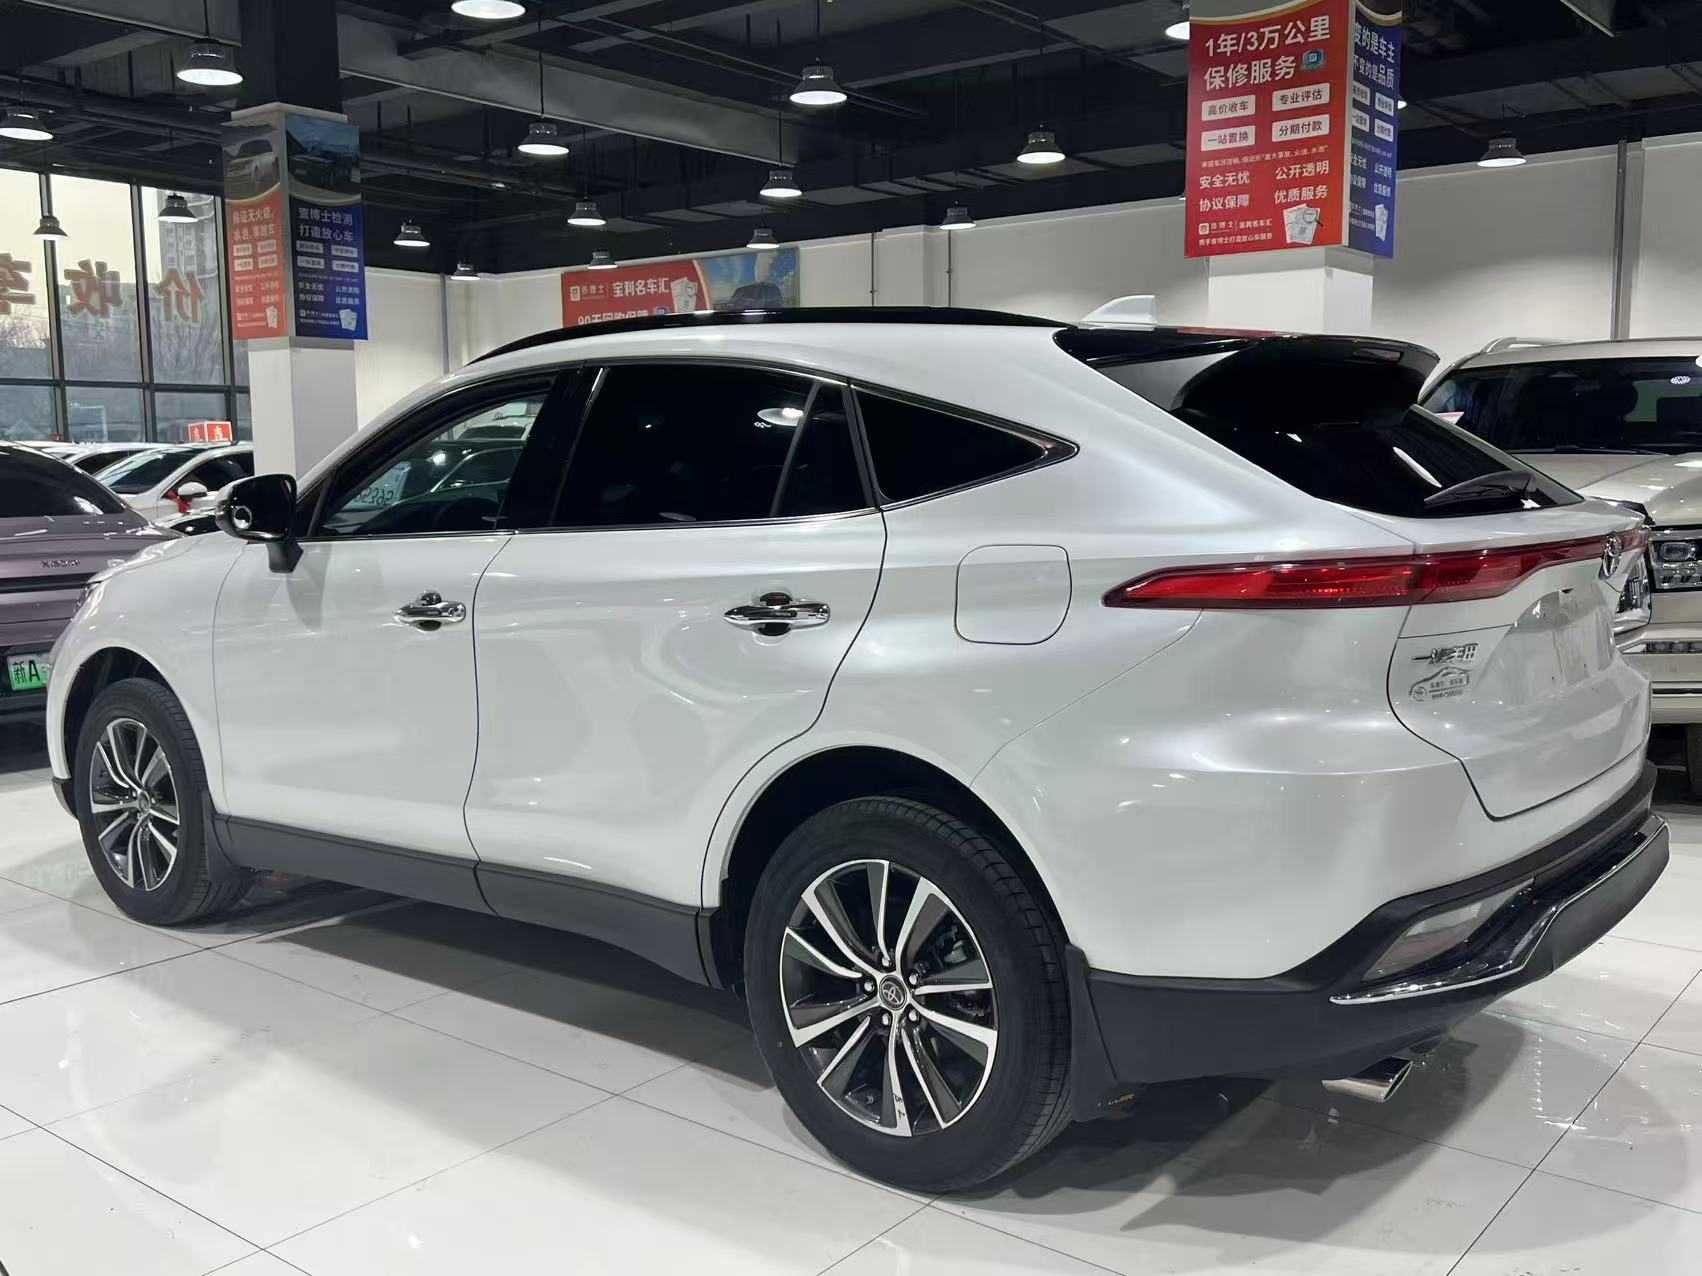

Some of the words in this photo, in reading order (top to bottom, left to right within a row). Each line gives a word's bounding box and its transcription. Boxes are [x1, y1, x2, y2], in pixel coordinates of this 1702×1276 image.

[1205, 15, 1331, 57] 1年/3万公里
[1204, 55, 1297, 92] 保修服务
[1279, 88, 1323, 105] 专业评估
[1279, 120, 1323, 137] 分期付款
[1199, 170, 1251, 189] 安全无忧
[1275, 160, 1329, 181] 公开透明
[1199, 194, 1249, 212] 协议保障
[1274, 184, 1329, 205] 优质服务
